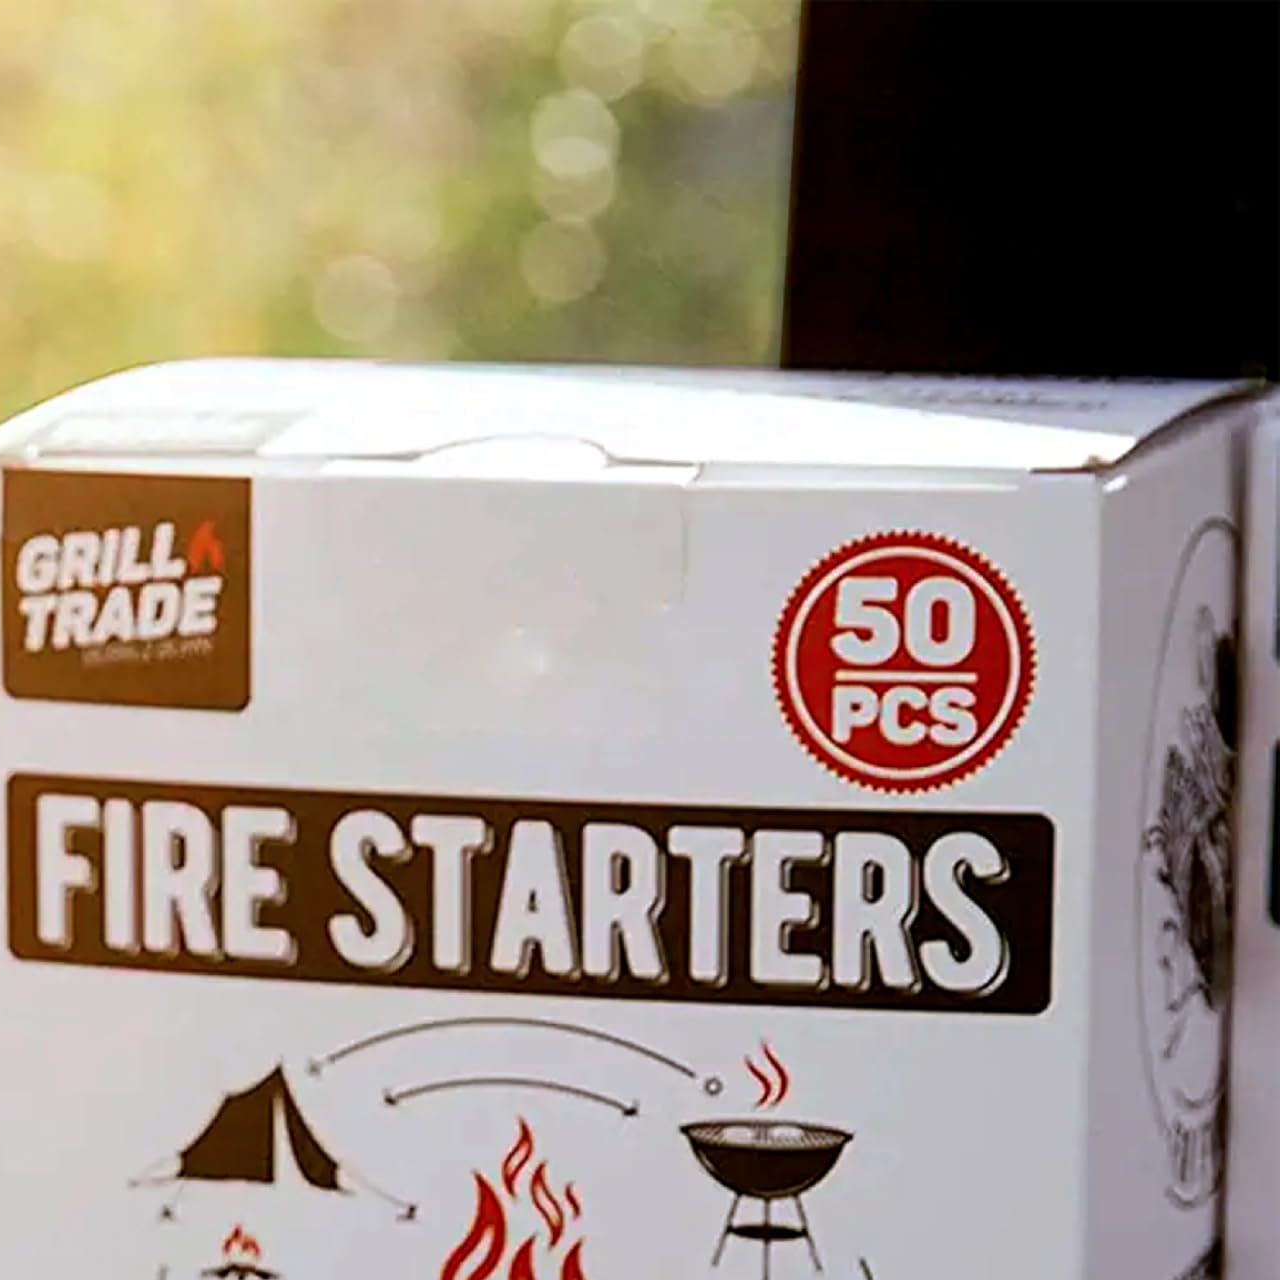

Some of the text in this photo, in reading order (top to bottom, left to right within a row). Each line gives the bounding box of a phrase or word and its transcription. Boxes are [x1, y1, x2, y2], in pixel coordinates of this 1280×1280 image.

[16, 521, 188, 593] GRILL
[19, 575, 223, 652] TRADE
[831, 576, 976, 667] 50
[831, 685, 978, 746] PCS
[34, 793, 1011, 998] FIRE STARTERS
